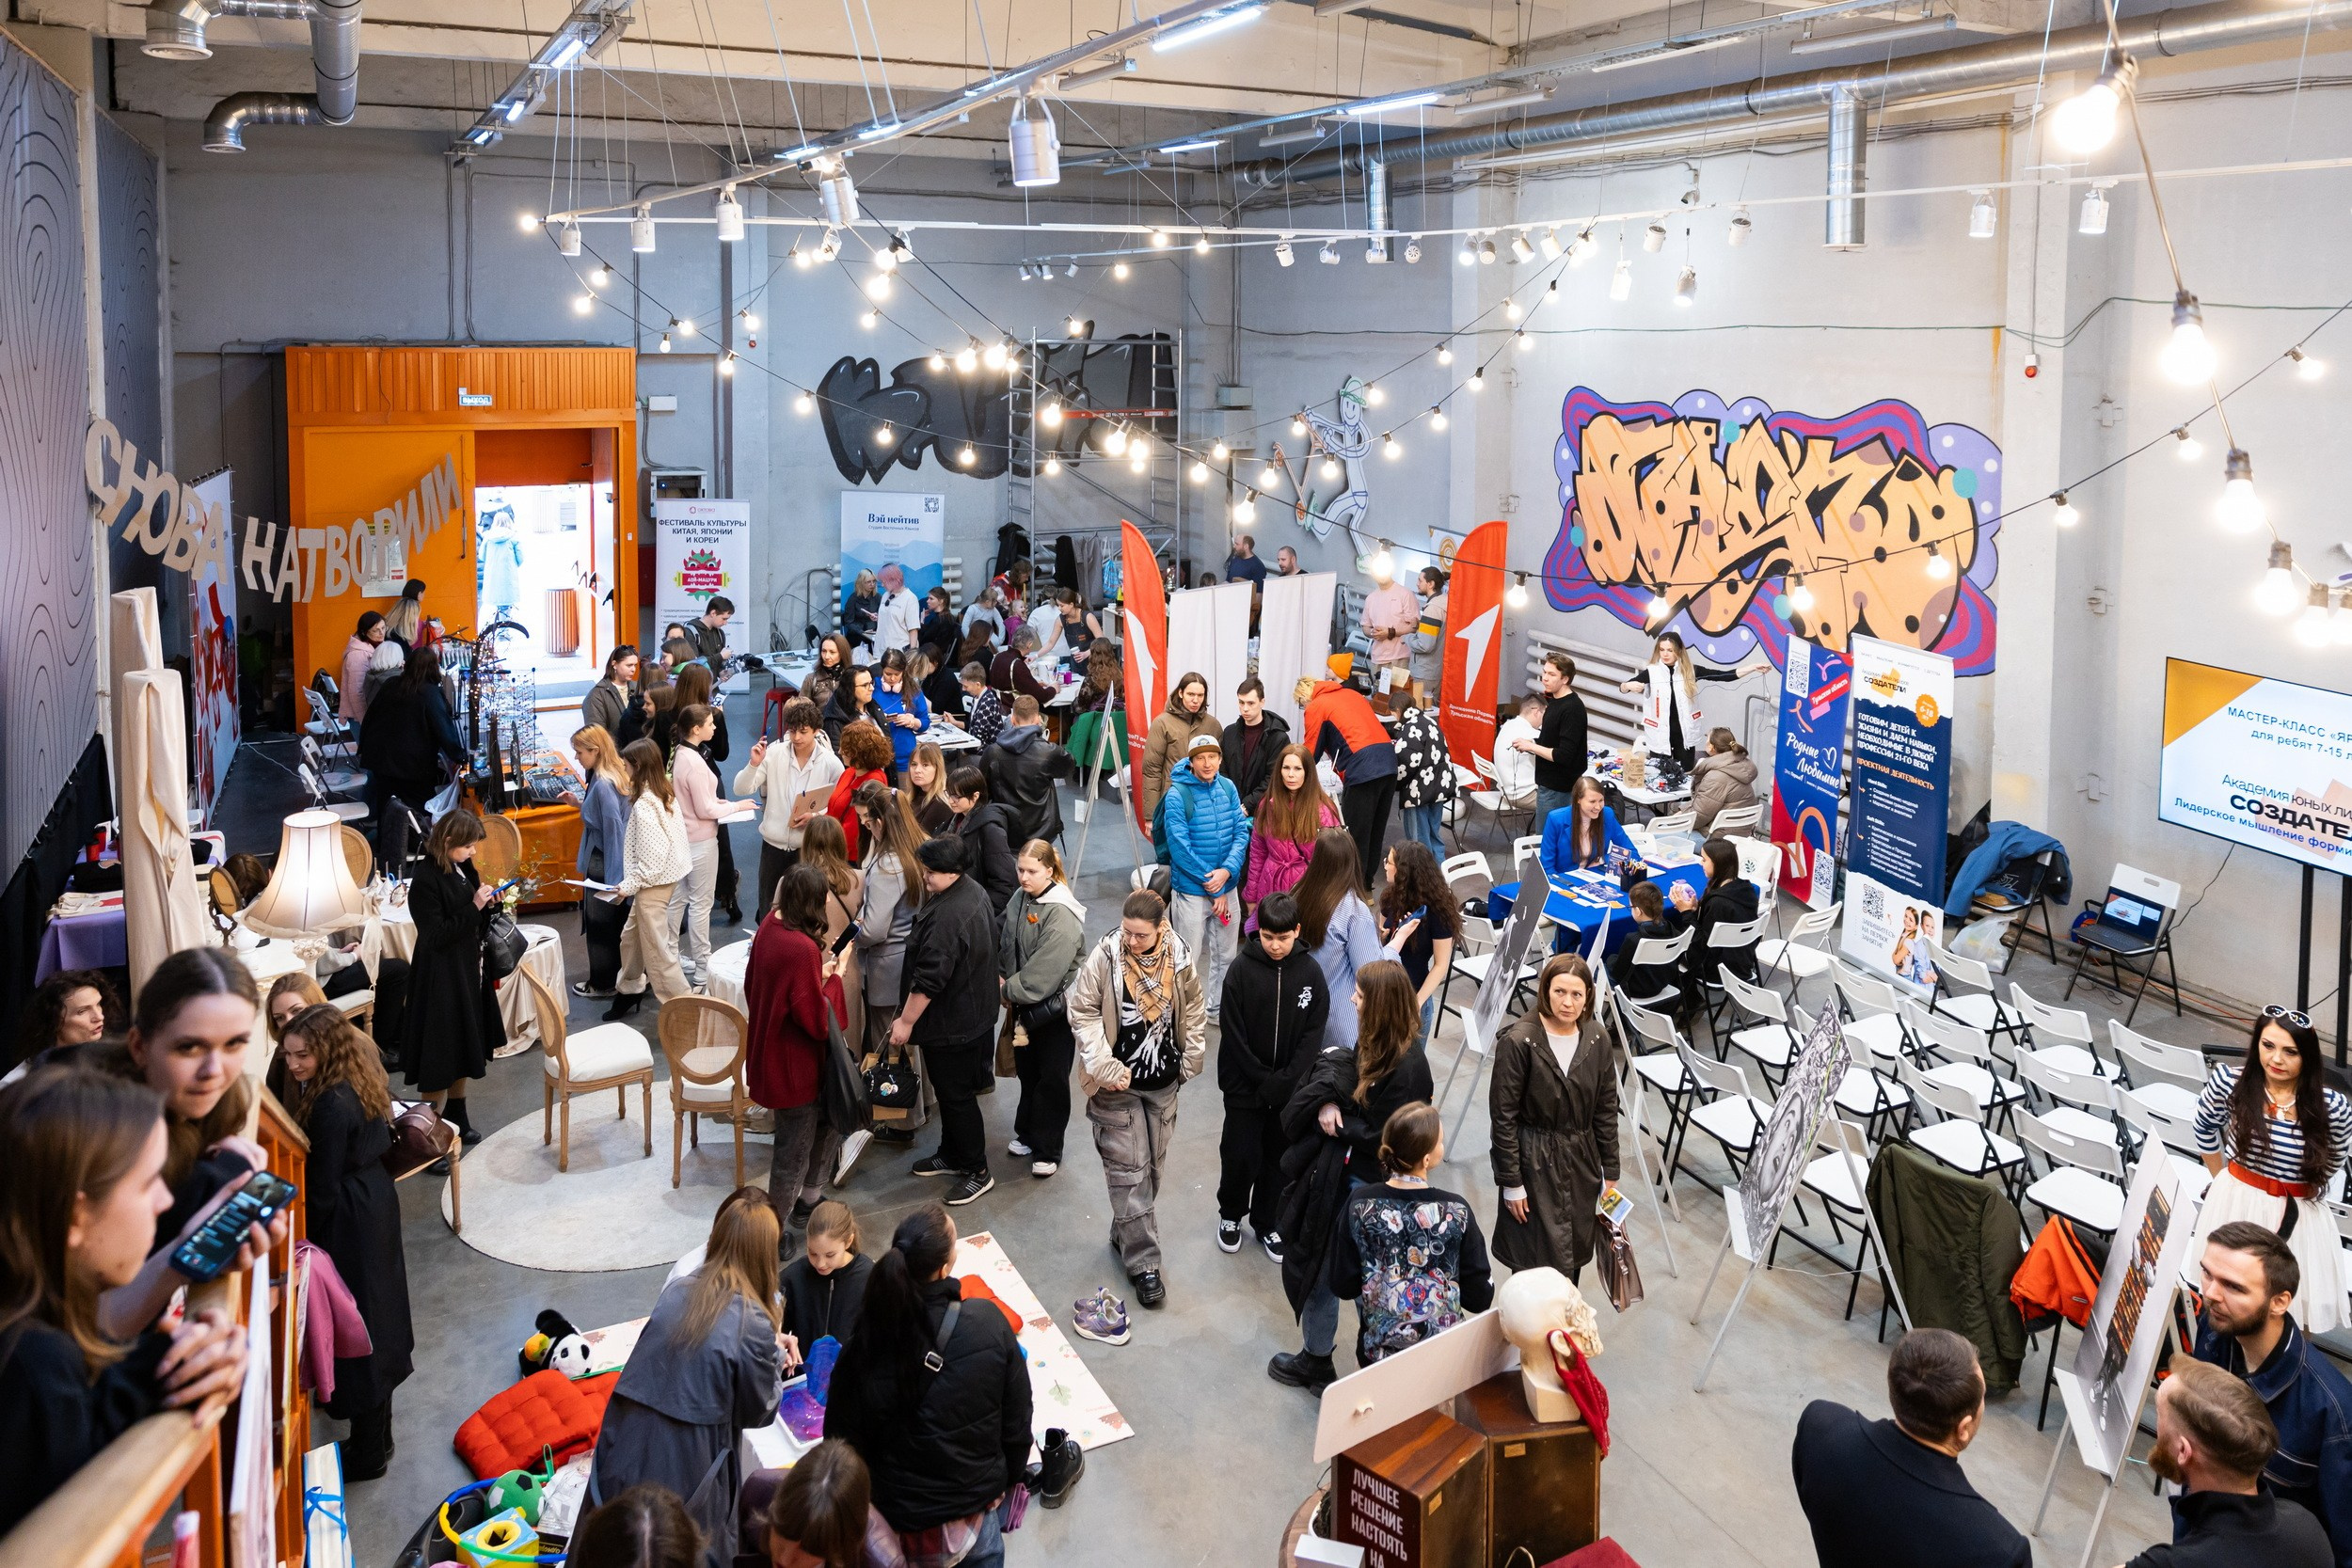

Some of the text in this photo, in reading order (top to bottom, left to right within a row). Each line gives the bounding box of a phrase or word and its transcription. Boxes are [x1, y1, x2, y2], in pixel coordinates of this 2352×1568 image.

[86, 419, 462, 603] СНОВА НАТВОРИЛИ
[868, 514, 919, 525] Вэй нейтив
[1864, 676, 1907, 693] СОЗДАТЕЛИ
[1449, 704, 1476, 714] Движение
[1858, 712, 1917, 737] ГОТОВИМ ДЕТЕЙ К
[1920, 705, 1934, 718] 6-18
[2228, 707, 2326, 737] МАСТЕР-КЛАСС
[1787, 732, 1819, 759] Родные
[1857, 731, 1904, 752] НЕОБХОДИМЫЕ
[1911, 748, 1934, 763] ЛЮБОЙ
[1858, 721, 1937, 755] ЖИЗНИ И ДАЕМ НАВЫКИ,
[2251, 730, 2274, 742] для
[2277, 736, 2312, 752] ребят
[2316, 743, 2343, 759] 7-15
[1857, 740, 1929, 771] ПРОФЕССИИ 21-ГО ВЕКА
[1797, 757, 1839, 788] Любимые
[1856, 757, 1935, 790] ПРОЕКТНАЯ ДЕЯТЕЛЬНОСТЬ
[2222, 774, 2290, 801] Академия
[2292, 795, 2331, 814] юных
[2175, 797, 2235, 822] Лидерское
[2239, 817, 2305, 843] мышление
[2230, 794, 2352, 841] СОЗДАТЕ
[1353, 1468, 1400, 1509] ЛУЧШЕЕ
[1351, 1489, 1404, 1536] РЕШЕНИЕ
[1351, 1512, 1407, 1561] НАСТОЯТЬ
[1370, 1548, 1385, 1568] НА
